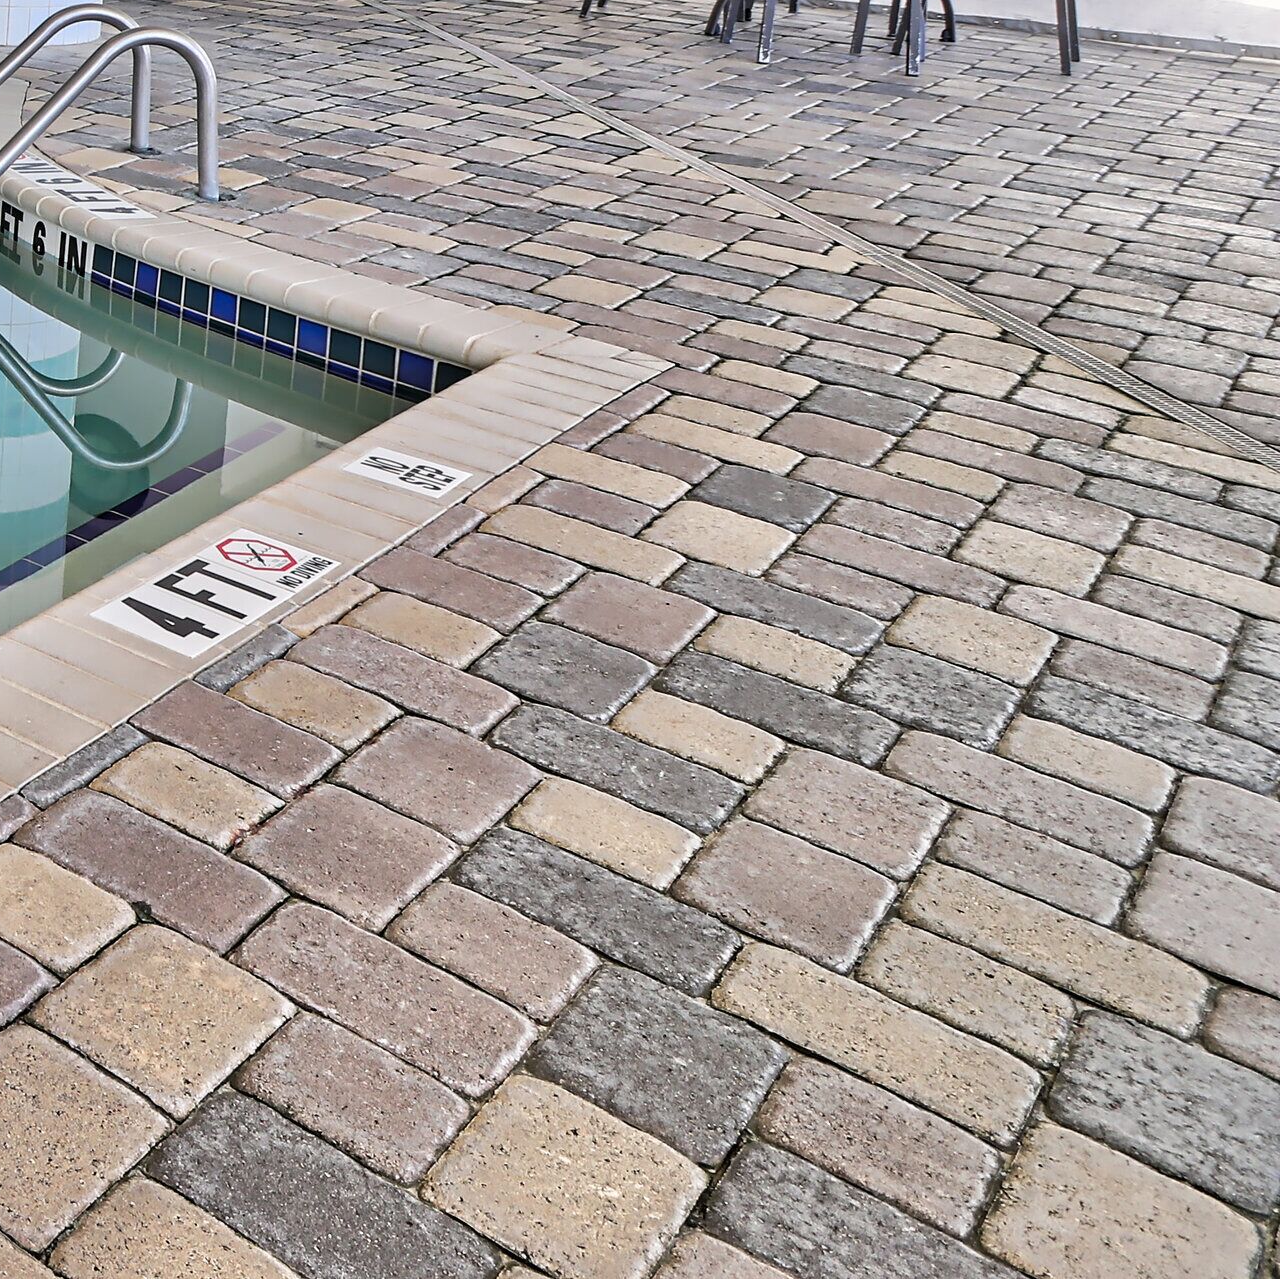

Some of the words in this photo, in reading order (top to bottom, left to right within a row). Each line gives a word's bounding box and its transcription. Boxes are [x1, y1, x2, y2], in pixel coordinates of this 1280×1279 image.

[32, 221, 47, 256] 6
[58, 230, 88, 278] IN
[360, 456, 410, 475] NO
[398, 465, 457, 491] STEP
[153, 558, 277, 620] FT
[275, 575, 303, 589] NO
[290, 556, 333, 580] DIVING
[121, 596, 220, 639] 4
